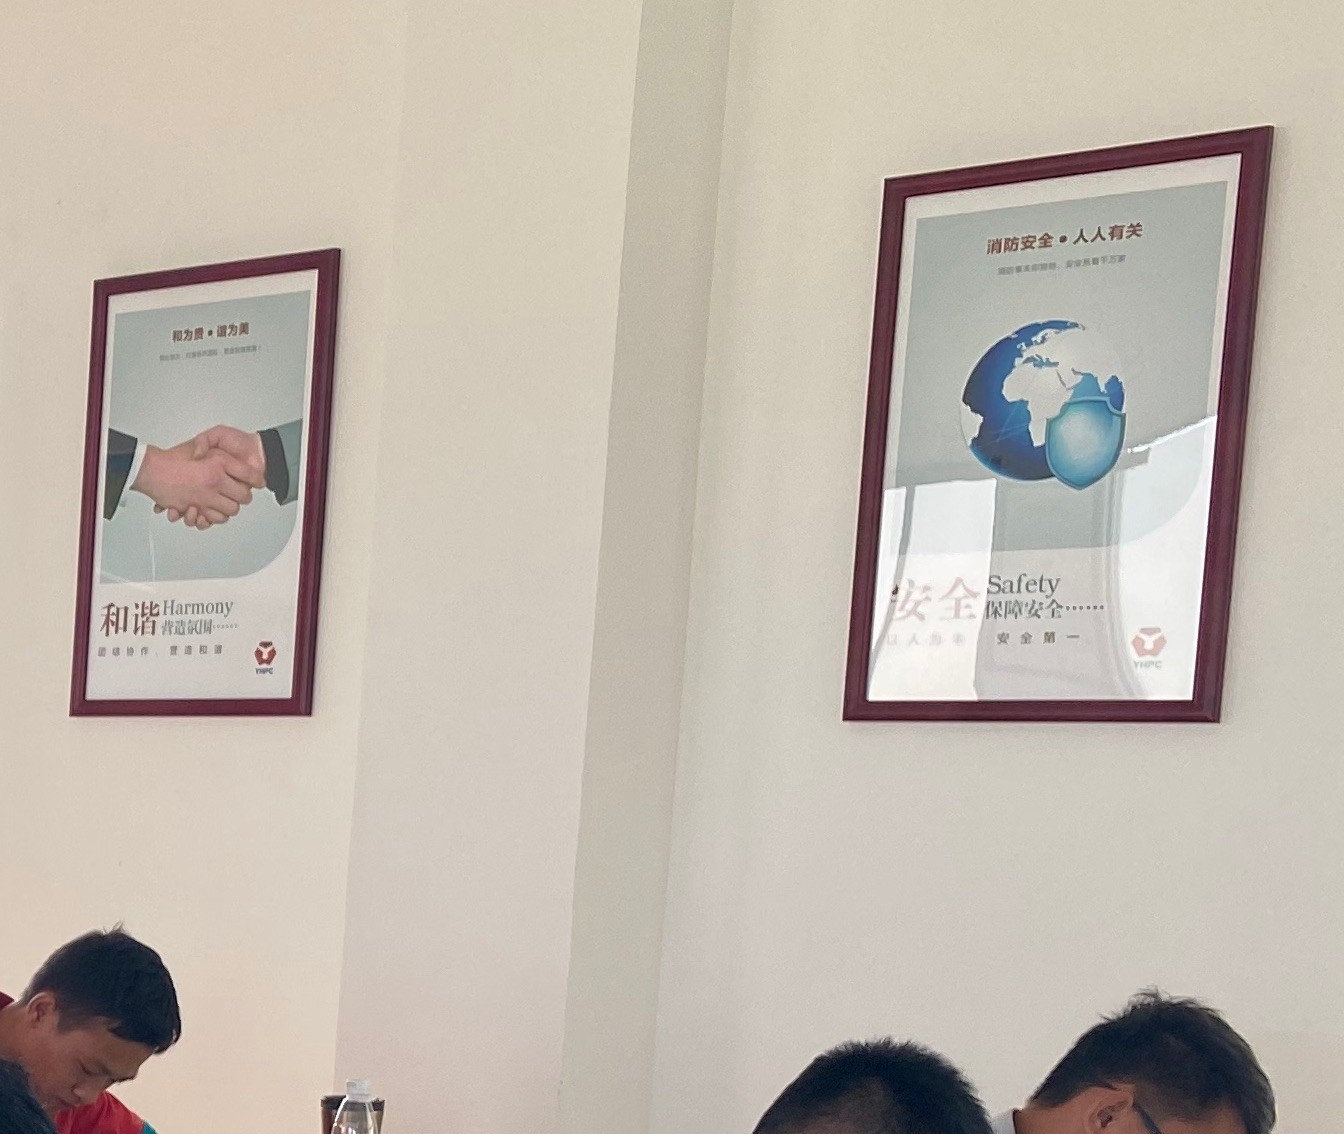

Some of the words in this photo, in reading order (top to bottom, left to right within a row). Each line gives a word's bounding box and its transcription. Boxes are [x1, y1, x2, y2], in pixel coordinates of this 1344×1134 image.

[892, 577, 981, 622] 安全
[987, 573, 1061, 598] Safety
[100, 601, 160, 637] 和谐
[162, 600, 234, 618] Harmony
